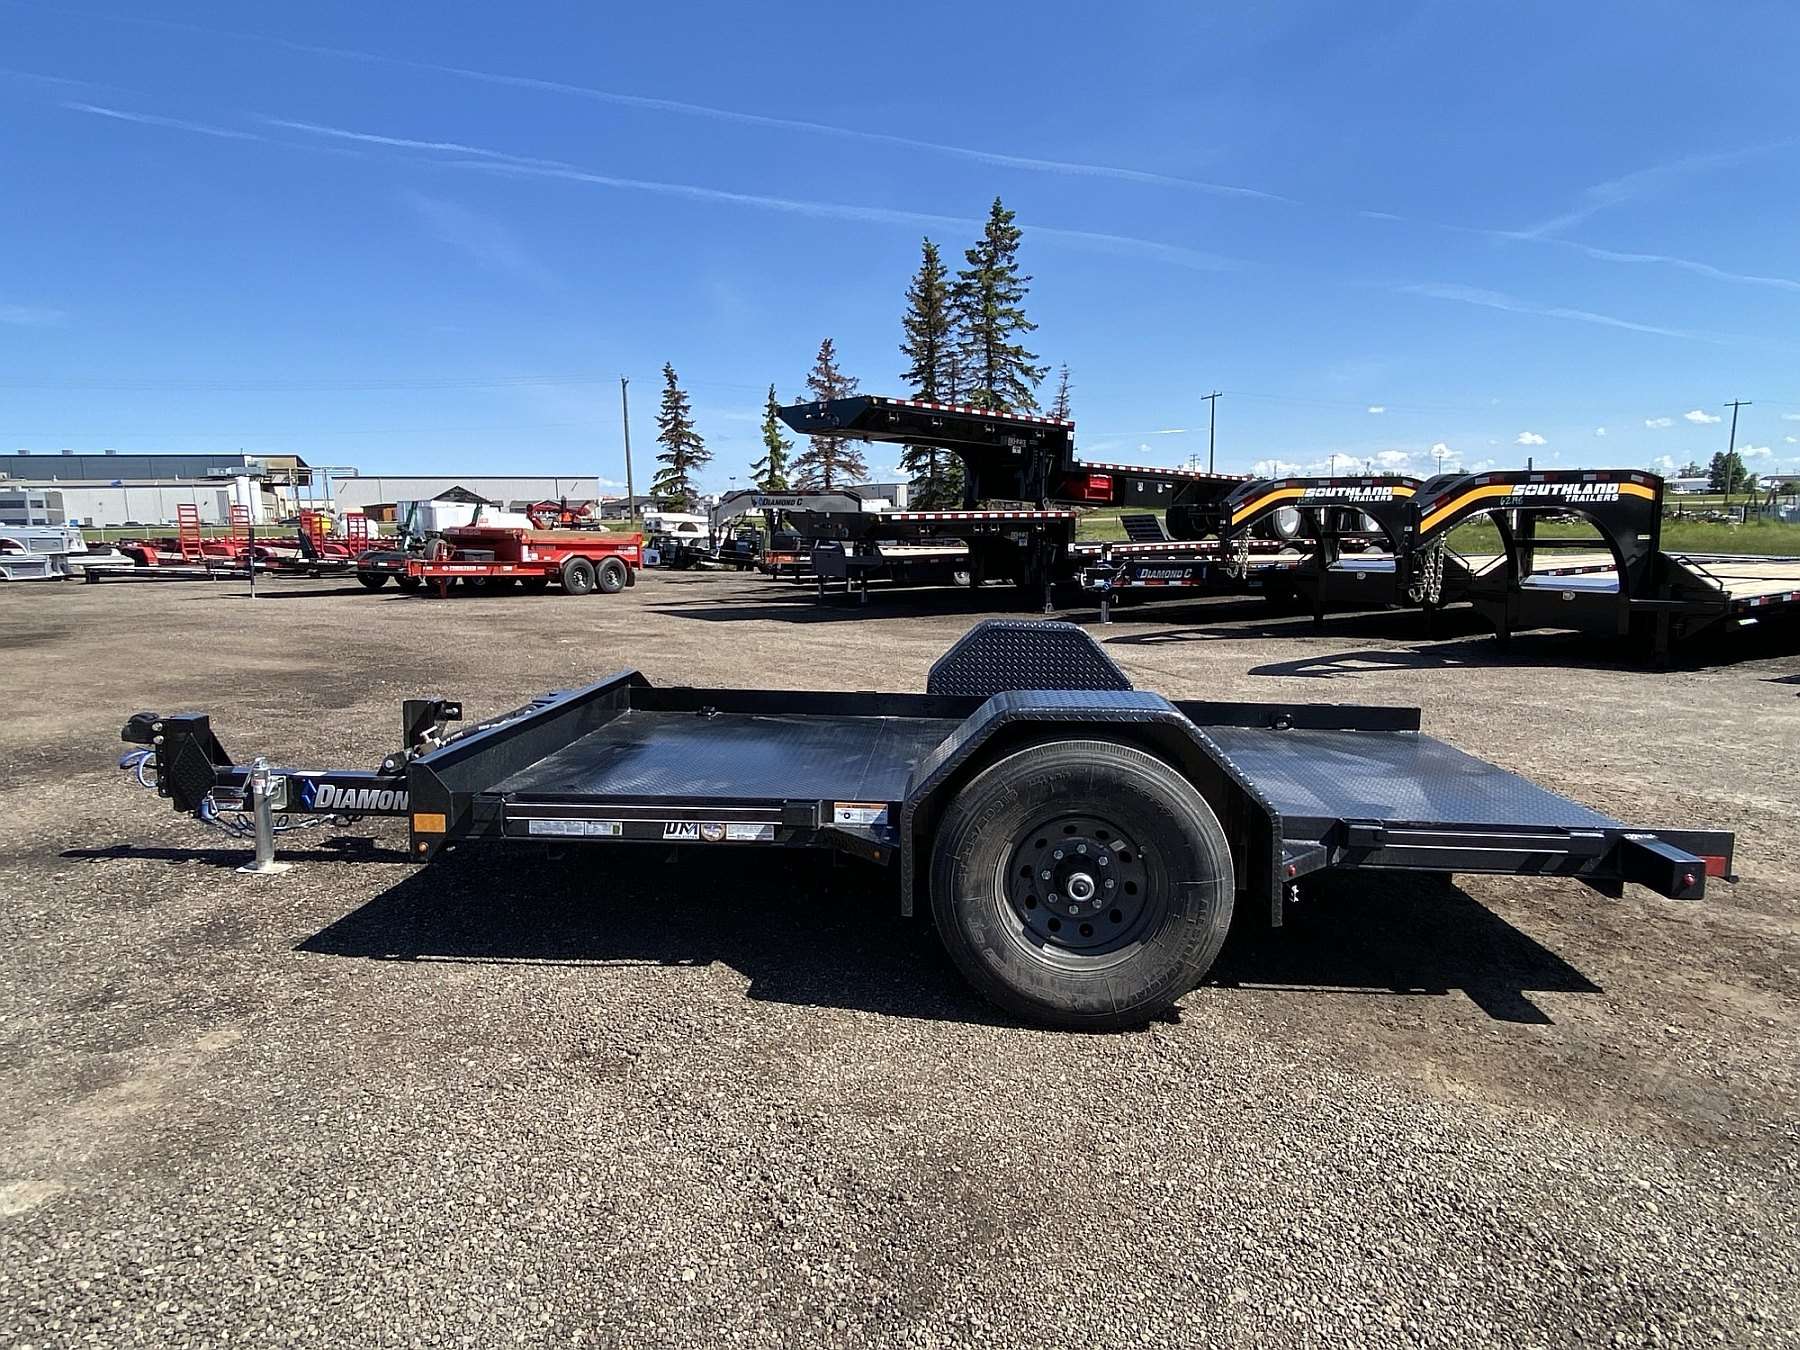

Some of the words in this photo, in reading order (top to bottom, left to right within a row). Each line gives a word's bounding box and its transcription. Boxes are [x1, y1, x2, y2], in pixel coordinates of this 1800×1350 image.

[1304, 487, 1393, 497] SOUTHLAND
[1512, 483, 1620, 496] SOUTHLAND
[762, 498, 796, 506] DIAMOND
[797, 497, 803, 506] C
[1348, 495, 1393, 503] TRAILERS
[1564, 494, 1619, 502] TRAILERS
[1140, 568, 1183, 579] DIAMOND
[1184, 568, 1193, 578] C
